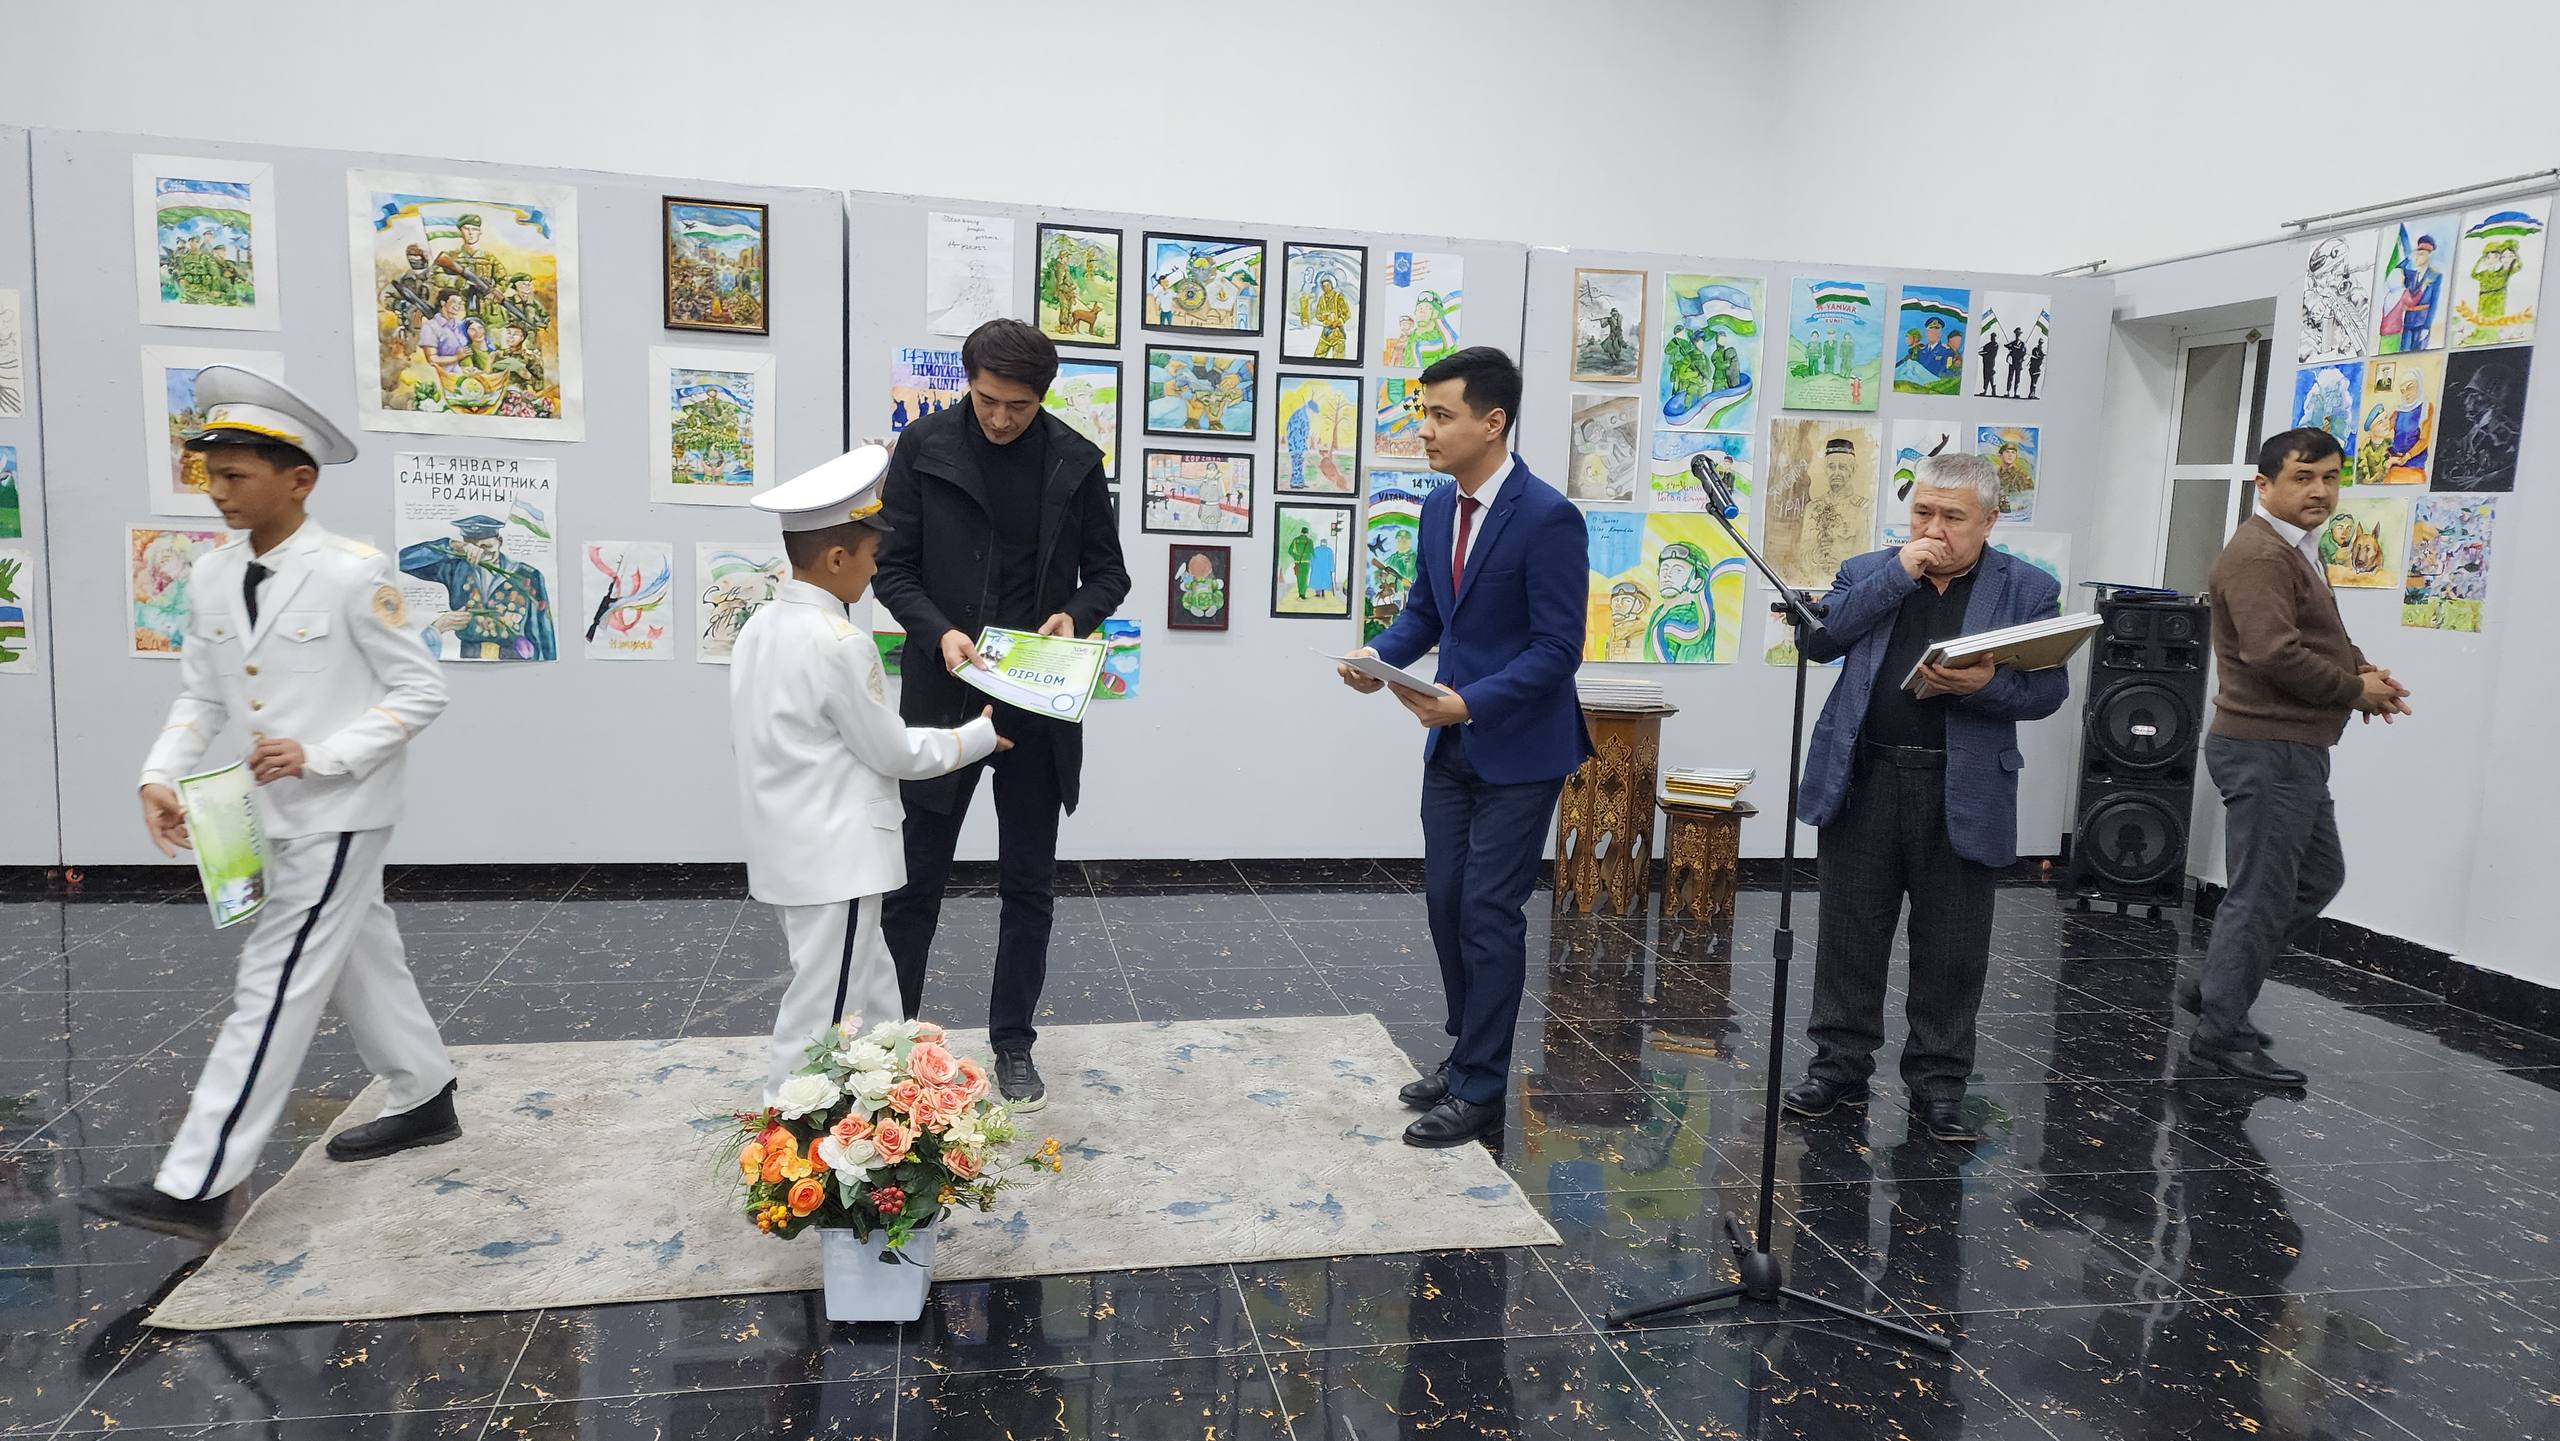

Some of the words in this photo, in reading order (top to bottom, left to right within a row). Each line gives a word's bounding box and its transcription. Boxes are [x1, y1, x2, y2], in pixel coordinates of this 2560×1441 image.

[928, 378, 960, 392] KUNI!
[412, 455, 519, 473] 14-ЯНВАРЯ
[400, 471, 408, 484] С
[411, 472, 454, 485] ДНЕМ
[461, 473, 550, 490] ЗАЩИТНИКА
[1412, 478, 1422, 489] 14
[431, 486, 513, 503] РОДИНЫ!
[1007, 668, 1066, 687] DIPLOM
